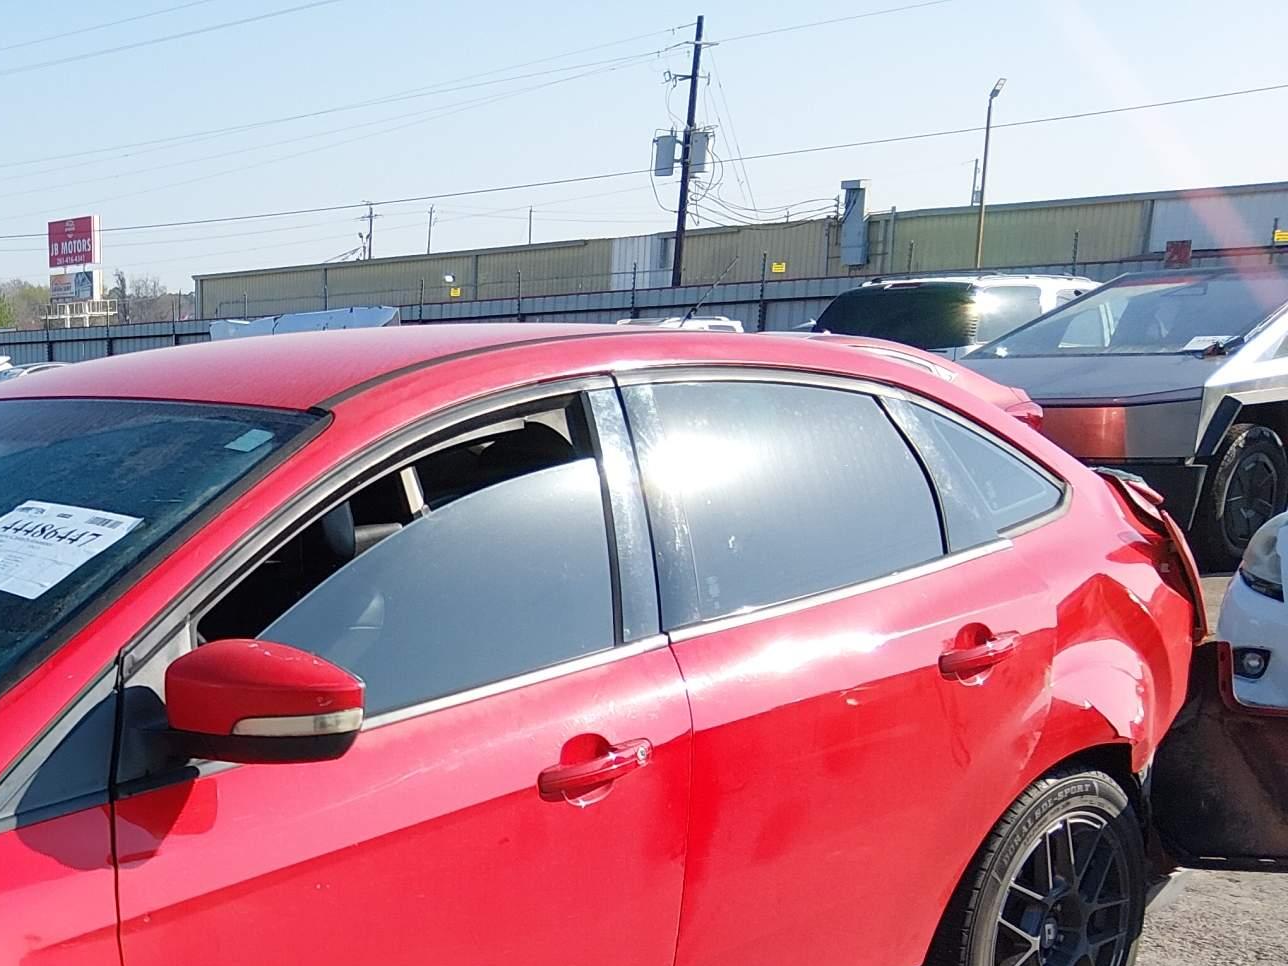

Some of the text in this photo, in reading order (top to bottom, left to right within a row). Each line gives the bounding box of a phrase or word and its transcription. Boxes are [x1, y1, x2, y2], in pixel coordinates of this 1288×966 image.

[51, 238, 91, 256] JB MOTORS
[2, 519, 103, 547] 44486447
